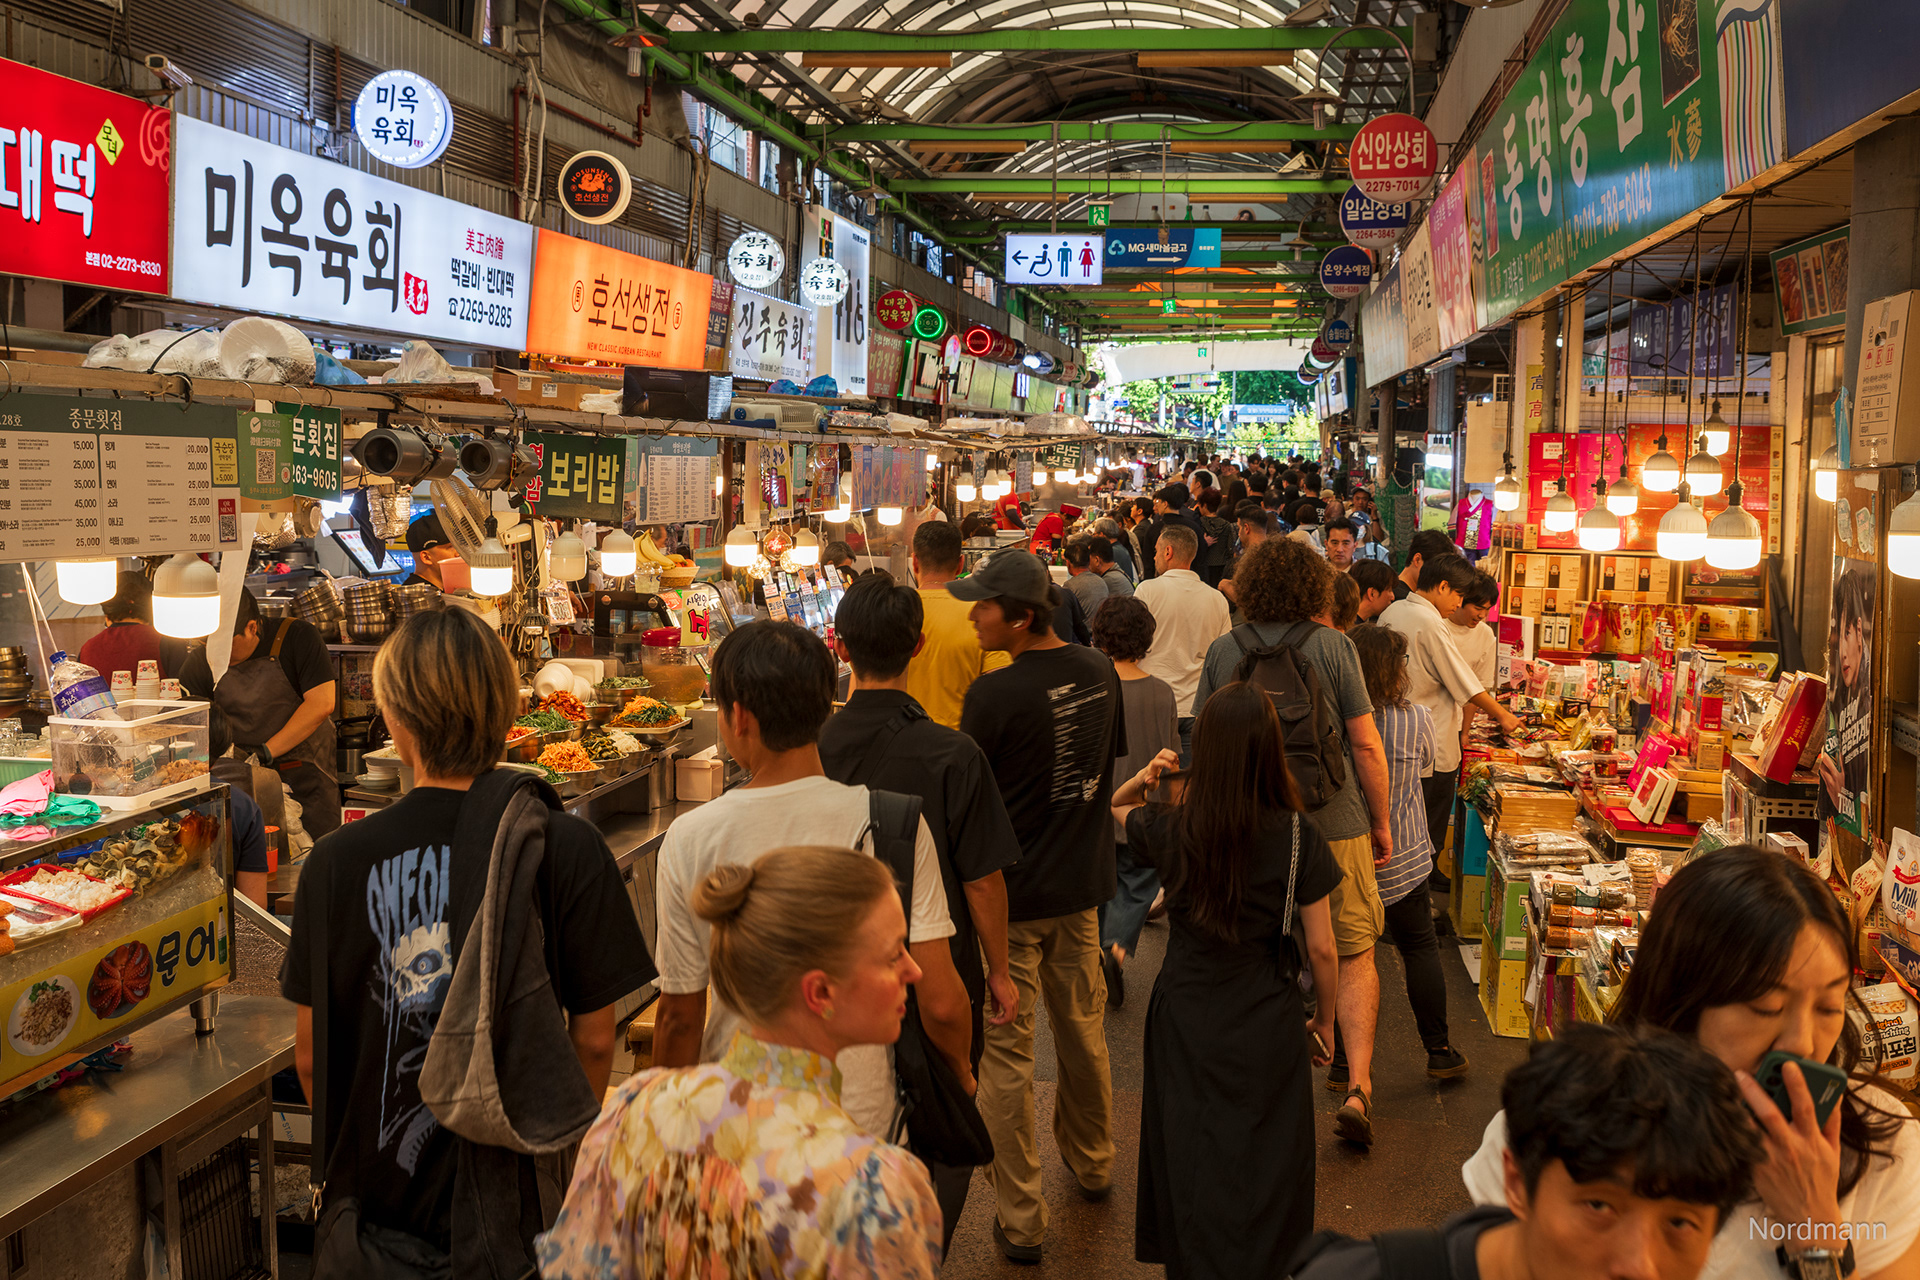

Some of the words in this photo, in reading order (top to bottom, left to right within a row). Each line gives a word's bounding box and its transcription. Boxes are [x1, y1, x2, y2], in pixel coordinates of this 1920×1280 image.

[376, 84, 418, 114] 미옥
[1503, 0, 1645, 240] 동명홍삼
[371, 118, 415, 147] 육회
[1357, 131, 1428, 170] 신안상회
[571, 168, 613, 183] HOSUNSENG
[1366, 180, 1420, 193] 2279-7014
[575, 193, 609, 202] 호선생전
[1344, 199, 1406, 221] 일심상회
[205, 159, 401, 312] 미옥육회
[1356, 229, 1395, 240] 2264-3845
[743, 236, 769, 249] 진주
[86, 251, 100, 266] 본점
[101, 254, 161, 276] 02-2273-8330
[733, 251, 774, 271] 육회
[812, 263, 836, 274] 진주
[1323, 263, 1370, 276] 온양수예점
[805, 275, 841, 292] 육회
[588, 273, 671, 337] 호선생전
[884, 297, 907, 309] 대광
[460, 297, 512, 329] 2269-8285
[738, 301, 804, 360] 진주육회
[587, 342, 597, 351] NEW
[598, 343, 617, 353] CLASSIC
[636, 346, 662, 358] RESTAURANT
[69, 408, 123, 431] 종문횟집
[73, 440, 94, 450] 15,000
[187, 444, 208, 454] 20,000
[73, 460, 95, 470] 25,000
[187, 462, 207, 471] 20,000
[219, 473, 233, 482] 5,000
[547, 451, 619, 504] 보리밥
[74, 479, 96, 490] 35,000
[188, 480, 209, 489] 25,000
[75, 499, 97, 509] 45,000
[188, 498, 210, 506] 25,000
[75, 518, 98, 529] 35,000
[190, 515, 210, 524] 25,000
[76, 537, 100, 547] 25,000
[189, 533, 211, 542] 20,000
[1891, 882, 1919, 911] Milk
[156, 921, 215, 987] 문어
[1865, 1016, 1903, 1032] Oiginal
